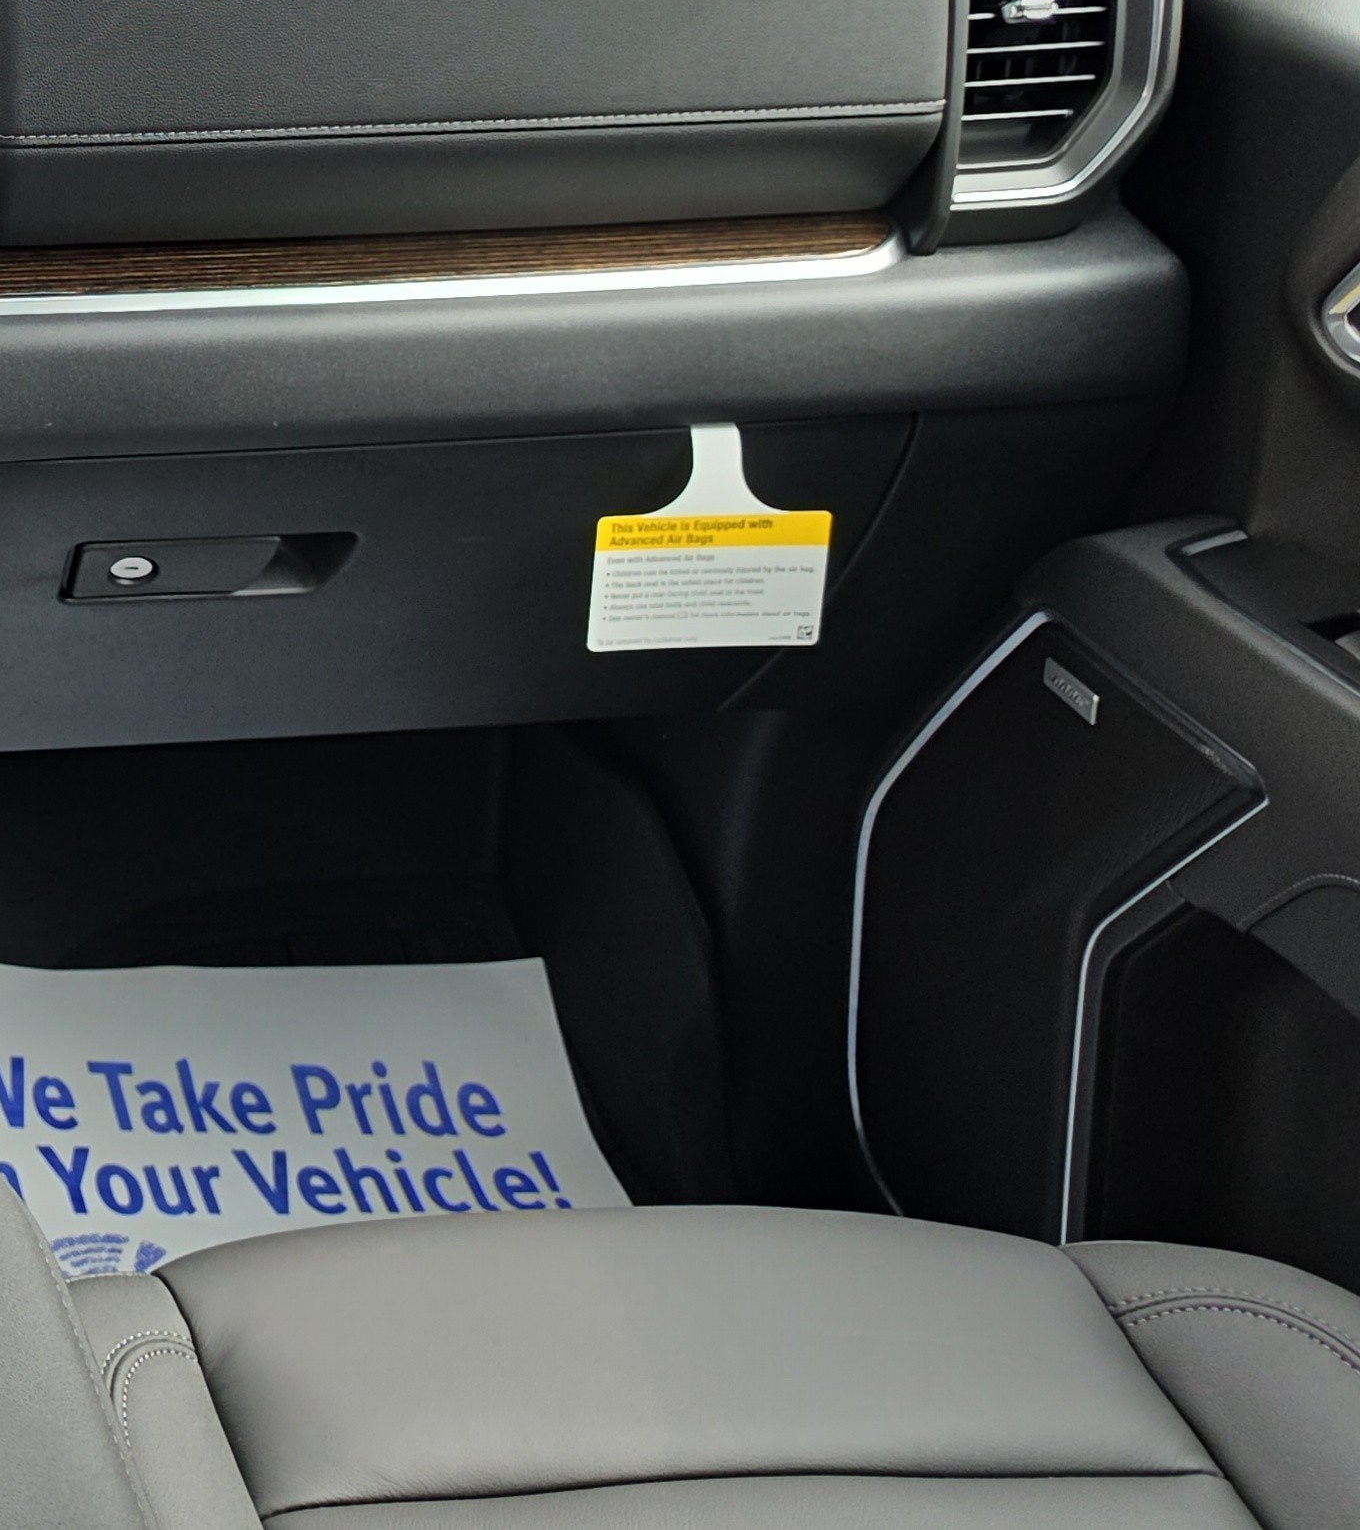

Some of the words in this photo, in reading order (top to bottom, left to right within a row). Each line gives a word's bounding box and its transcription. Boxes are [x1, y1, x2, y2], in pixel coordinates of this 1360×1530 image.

[609, 534, 664, 547] Advanced
[667, 534, 682, 545] Air
[686, 534, 714, 546] Bags
[611, 522, 633, 534] This
[637, 522, 677, 533] Vehicle
[681, 521, 690, 532] is
[693, 520, 745, 533] Equipped
[748, 518, 773, 529] with
[88, 1058, 277, 1135] Take
[290, 1060, 507, 1139] Pride
[37, 1144, 221, 1216] Your
[230, 1148, 571, 1216] Vehicle!
